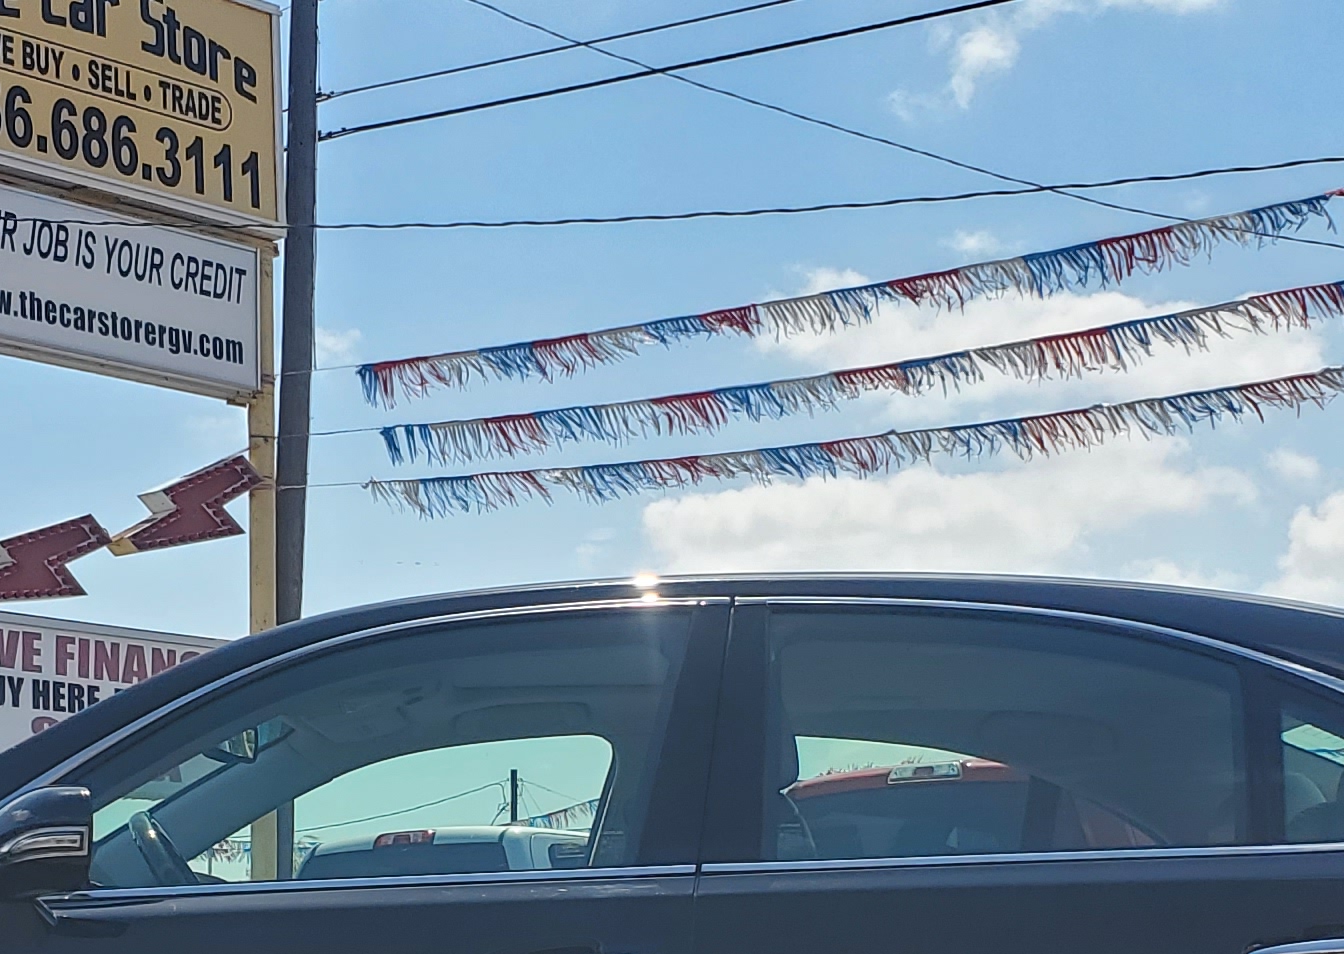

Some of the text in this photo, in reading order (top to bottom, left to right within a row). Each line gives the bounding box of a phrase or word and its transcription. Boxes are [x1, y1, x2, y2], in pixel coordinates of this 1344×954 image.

[22, 39, 65, 79] BUY
[87, 59, 137, 101] SELL
[158, 79, 223, 126] TRADE
[139, 0, 258, 104] Store
[22, 219, 69, 262] JOB
[75, 228, 97, 269] IS
[104, 235, 164, 286] YOUR
[170, 252, 247, 304] CREDIT
[32, 678, 101, 714] HERE
[55, 634, 202, 684] FINAN
